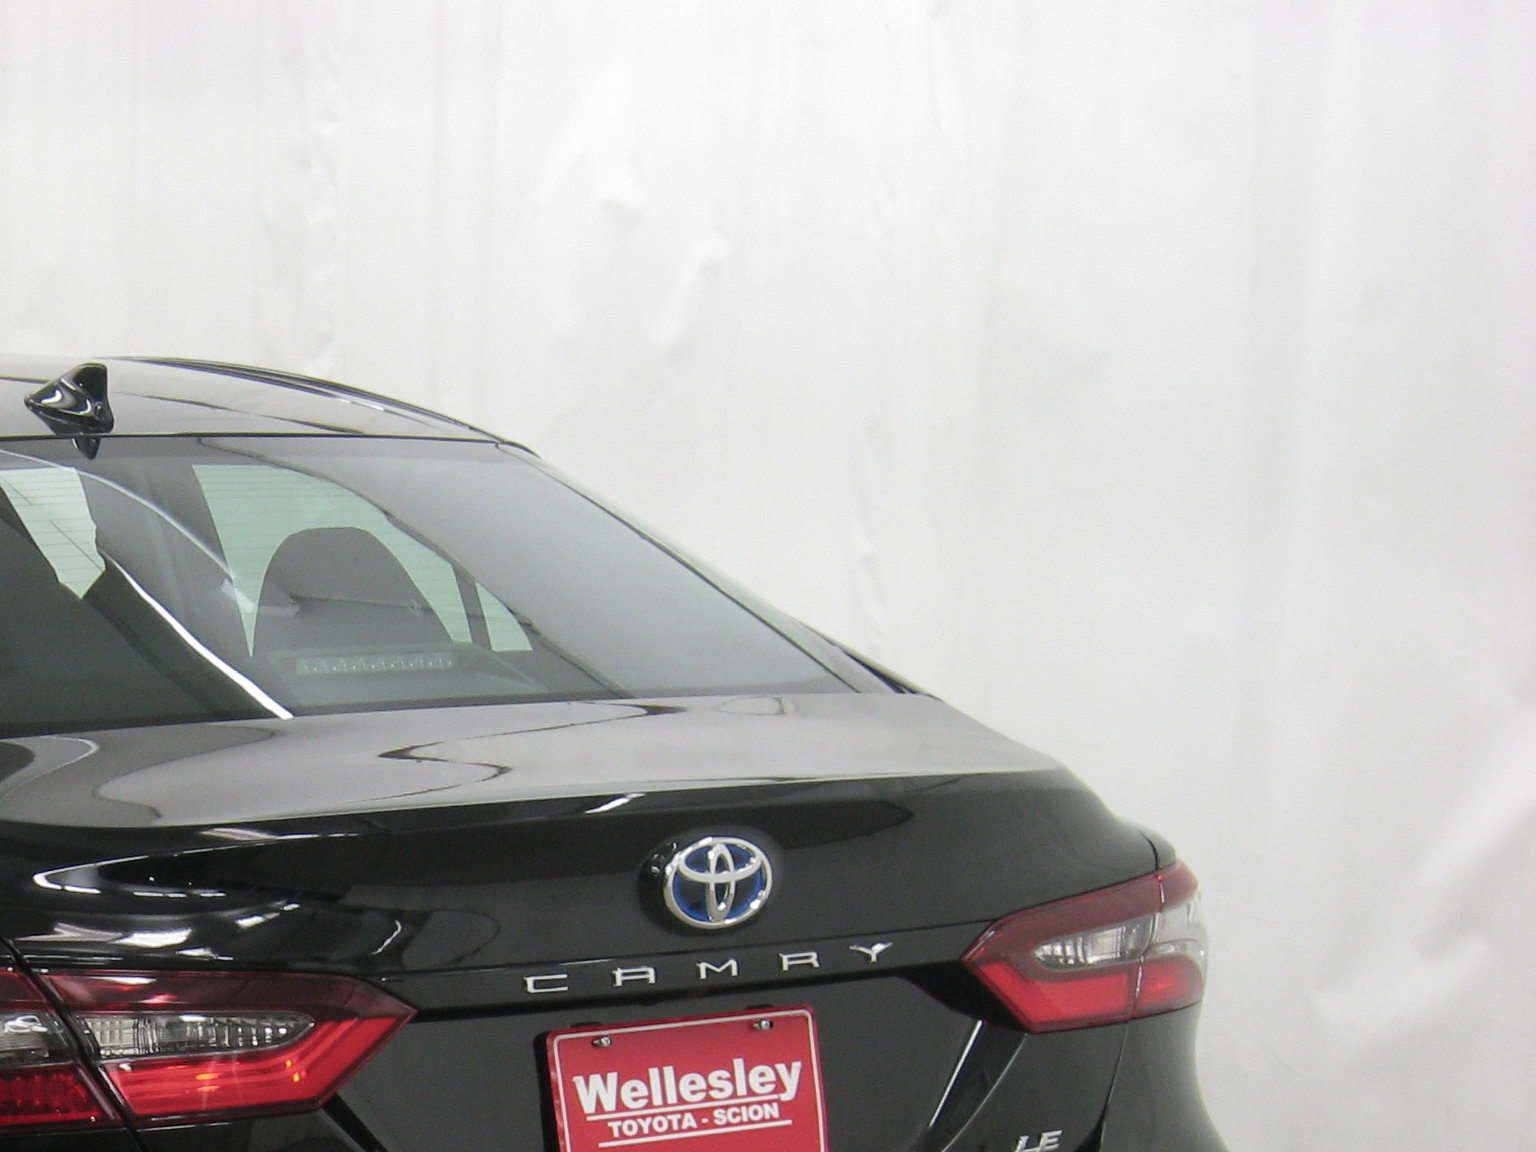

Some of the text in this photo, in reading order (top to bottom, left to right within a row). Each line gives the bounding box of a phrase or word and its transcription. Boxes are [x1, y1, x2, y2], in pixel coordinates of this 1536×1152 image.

[524, 942, 893, 993] CAMRY
[573, 1058, 802, 1114] Wellesley
[608, 1112, 697, 1137] TOYOTA
[713, 1102, 779, 1126] SCION
